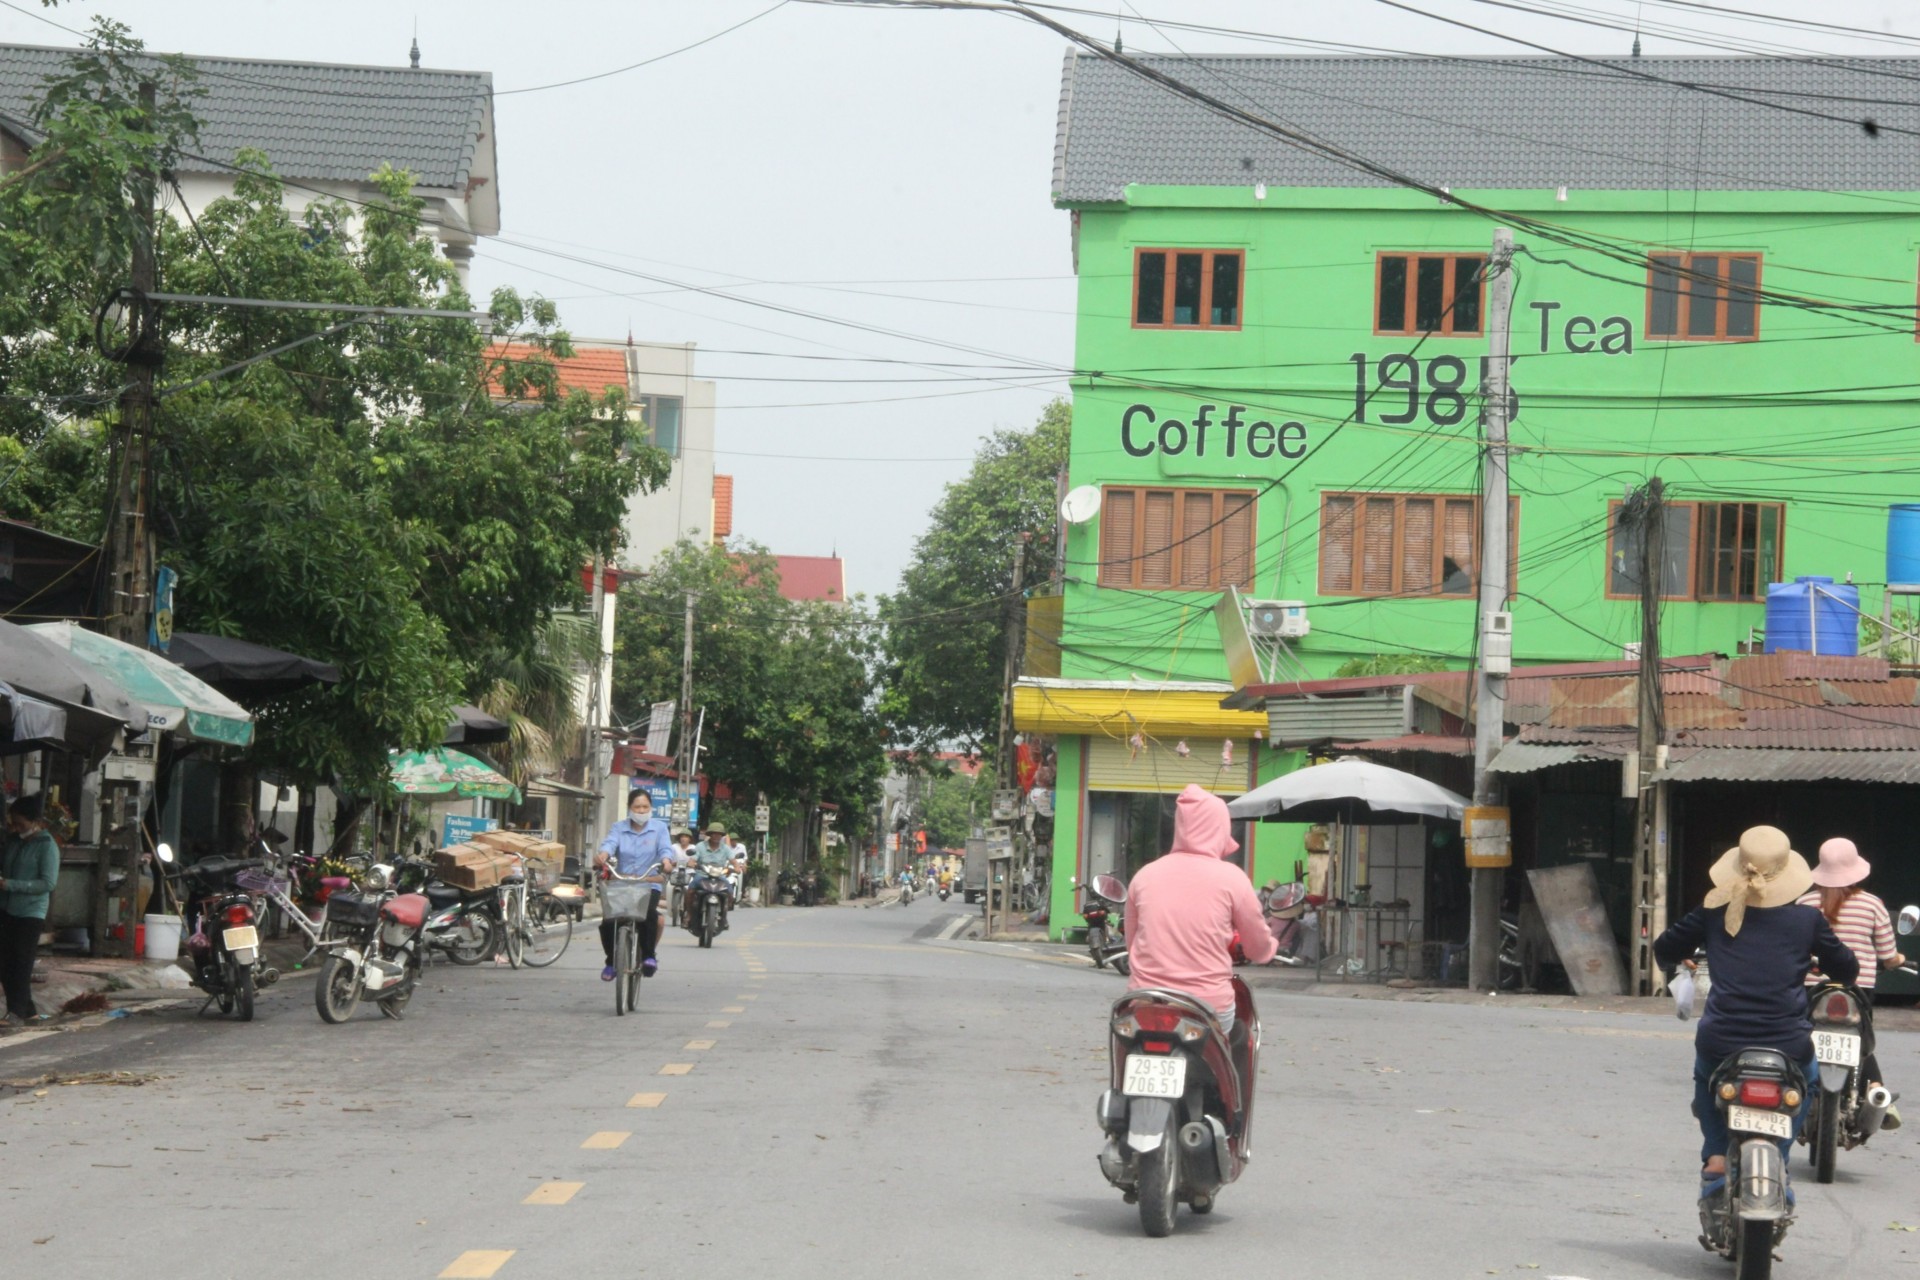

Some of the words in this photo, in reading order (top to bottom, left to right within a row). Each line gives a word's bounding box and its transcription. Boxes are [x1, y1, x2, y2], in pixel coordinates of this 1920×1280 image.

[1530, 301, 1634, 356] Tea
[1121, 403, 1308, 460] Coffee
[447, 817, 472, 828] Fashion
[1134, 1058, 1176, 1076] 29-S6
[1127, 1075, 1178, 1095] 706.51
[1733, 1118, 1787, 1137] 614.41
